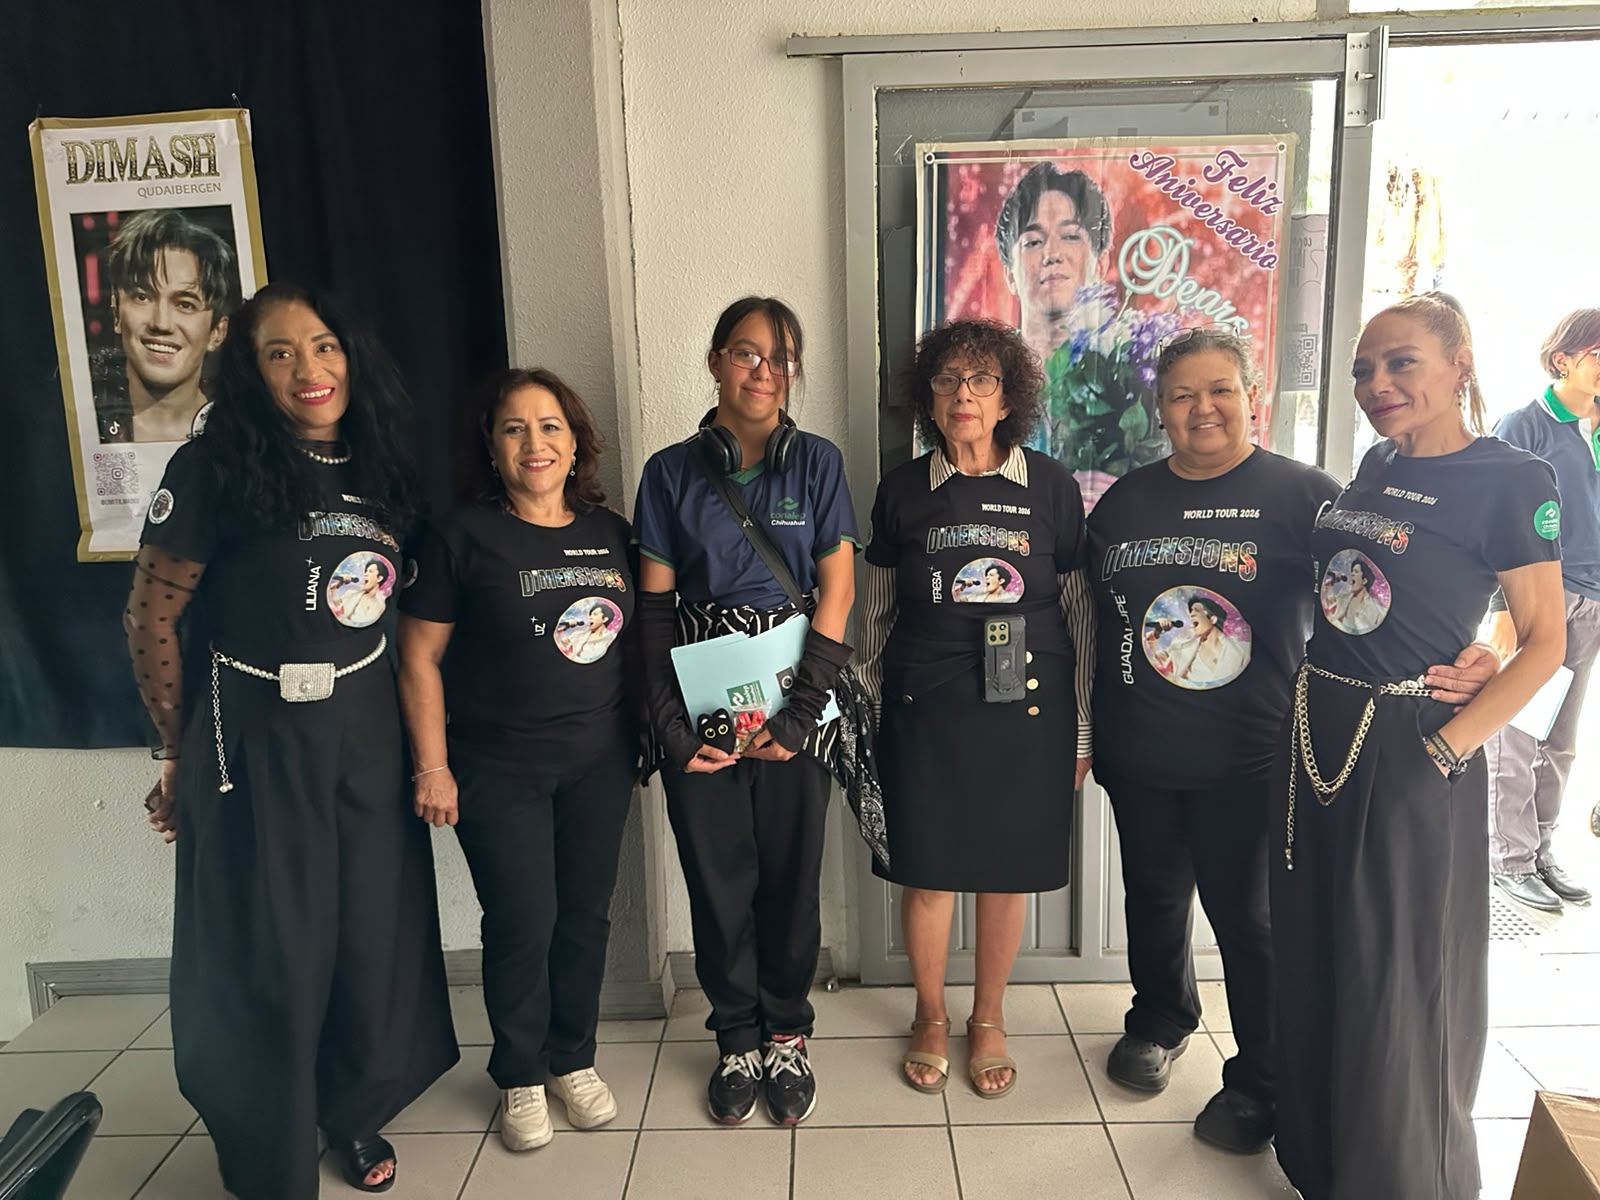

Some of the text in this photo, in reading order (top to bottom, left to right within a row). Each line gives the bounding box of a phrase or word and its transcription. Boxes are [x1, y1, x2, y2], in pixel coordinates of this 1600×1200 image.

[60, 132, 220, 185] DIMASH
[137, 182, 222, 198] QUDAIBERGEN
[1203, 149, 1283, 216] Feliz
[1128, 151, 1278, 270] Aniversario
[981, 503, 1002, 512] WORLD
[1002, 504, 1018, 514] TOUR
[1183, 508, 1261, 520] WORLD TOUR 2026
[305, 565, 321, 611] LILIANA
